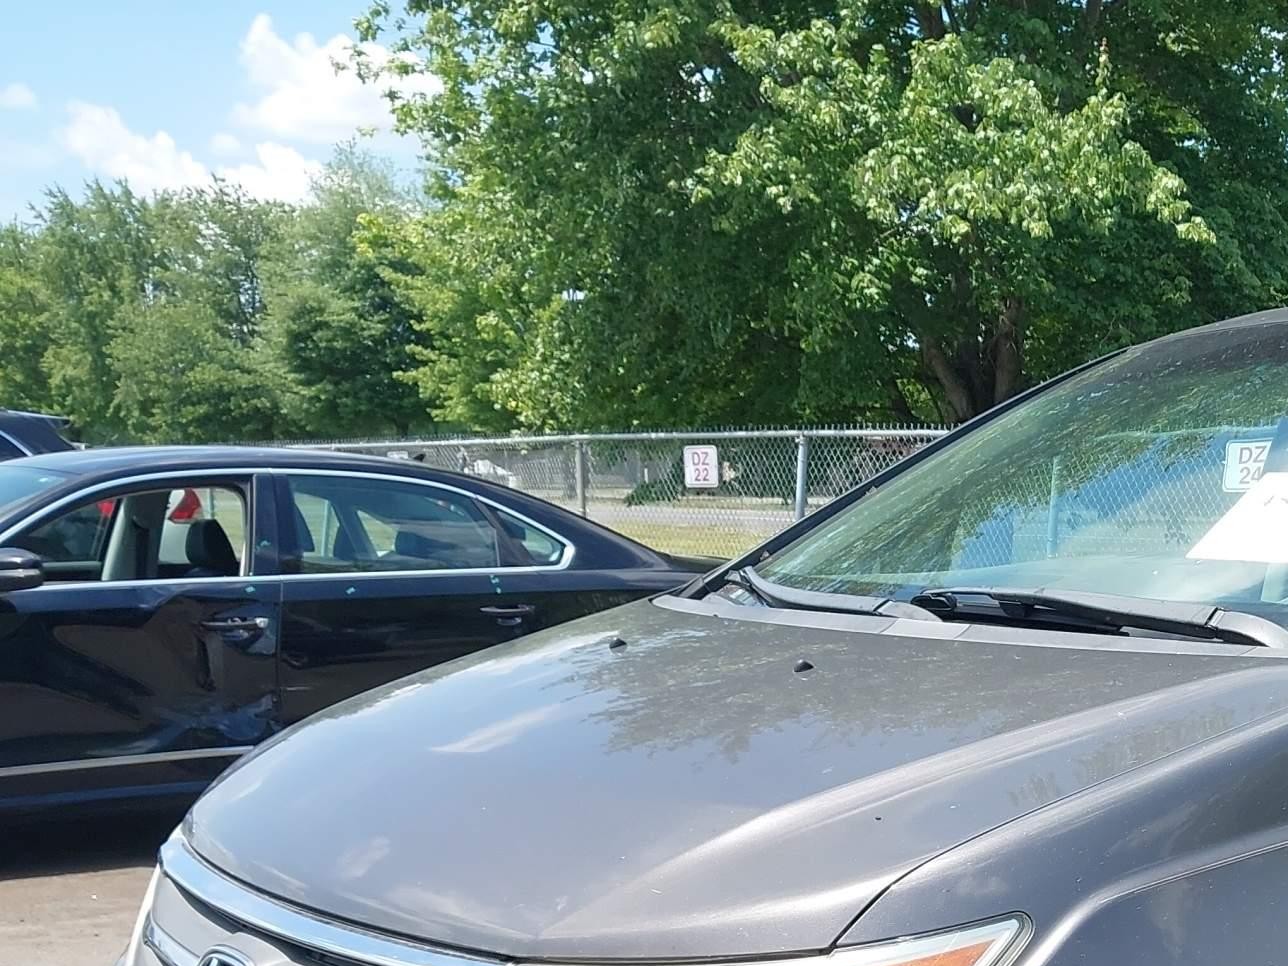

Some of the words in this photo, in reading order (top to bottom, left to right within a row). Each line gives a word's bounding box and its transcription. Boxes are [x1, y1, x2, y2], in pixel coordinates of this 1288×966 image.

[691, 451, 710, 466] DZ
[1238, 445, 1267, 464] DZ
[694, 468, 710, 482] 22
